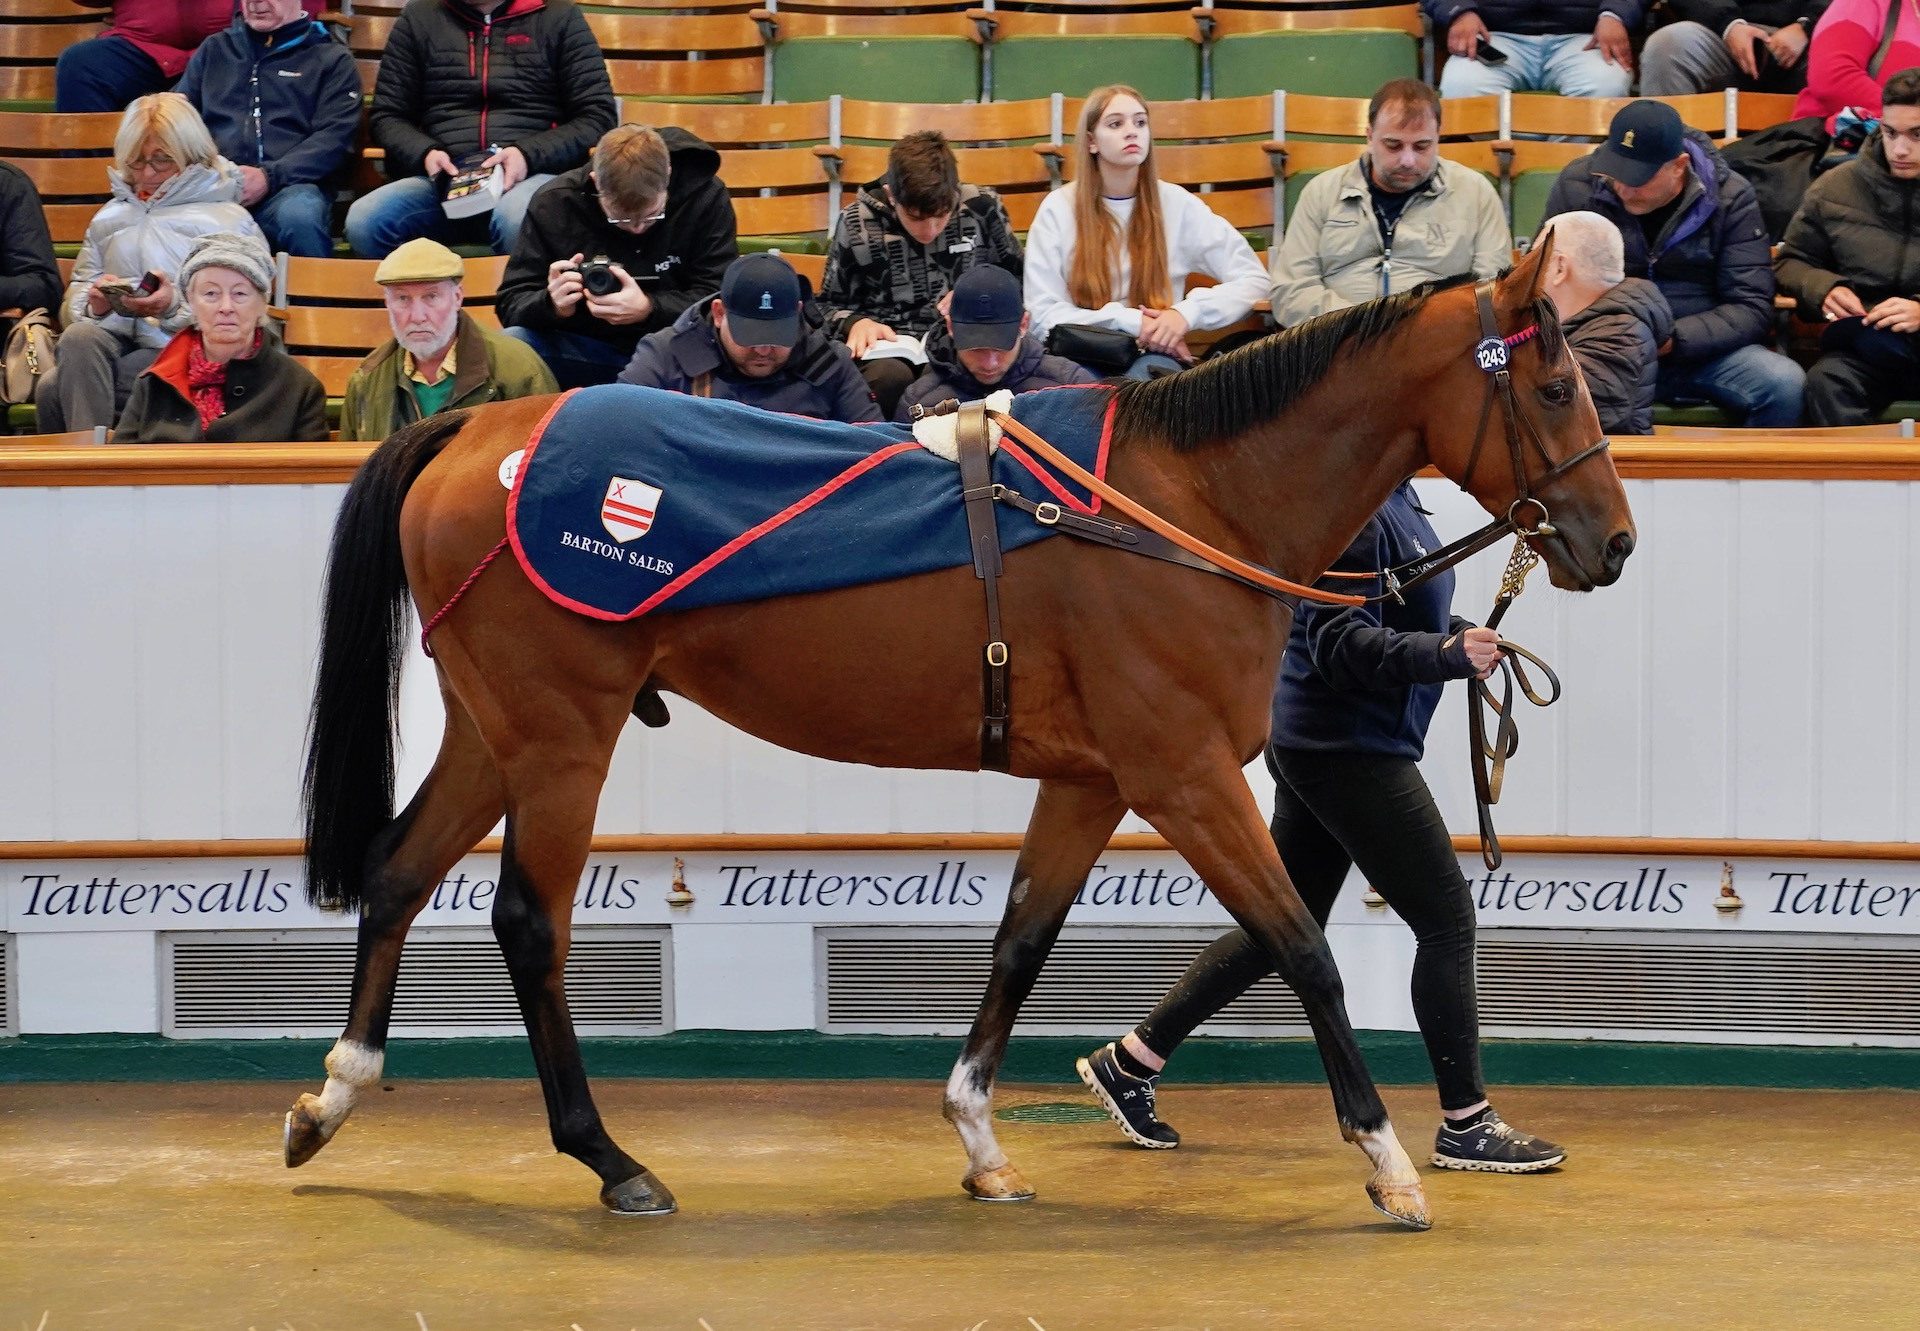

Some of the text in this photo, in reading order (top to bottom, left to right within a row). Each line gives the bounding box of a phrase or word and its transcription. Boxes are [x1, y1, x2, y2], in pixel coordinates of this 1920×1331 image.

[1477, 347, 1507, 369] 1243
[560, 531, 674, 576] BARTON SALES
[20, 868, 291, 916] Tattersalls
[718, 861, 987, 906] Tattersalls
[1768, 872, 1920, 917] Tatter
